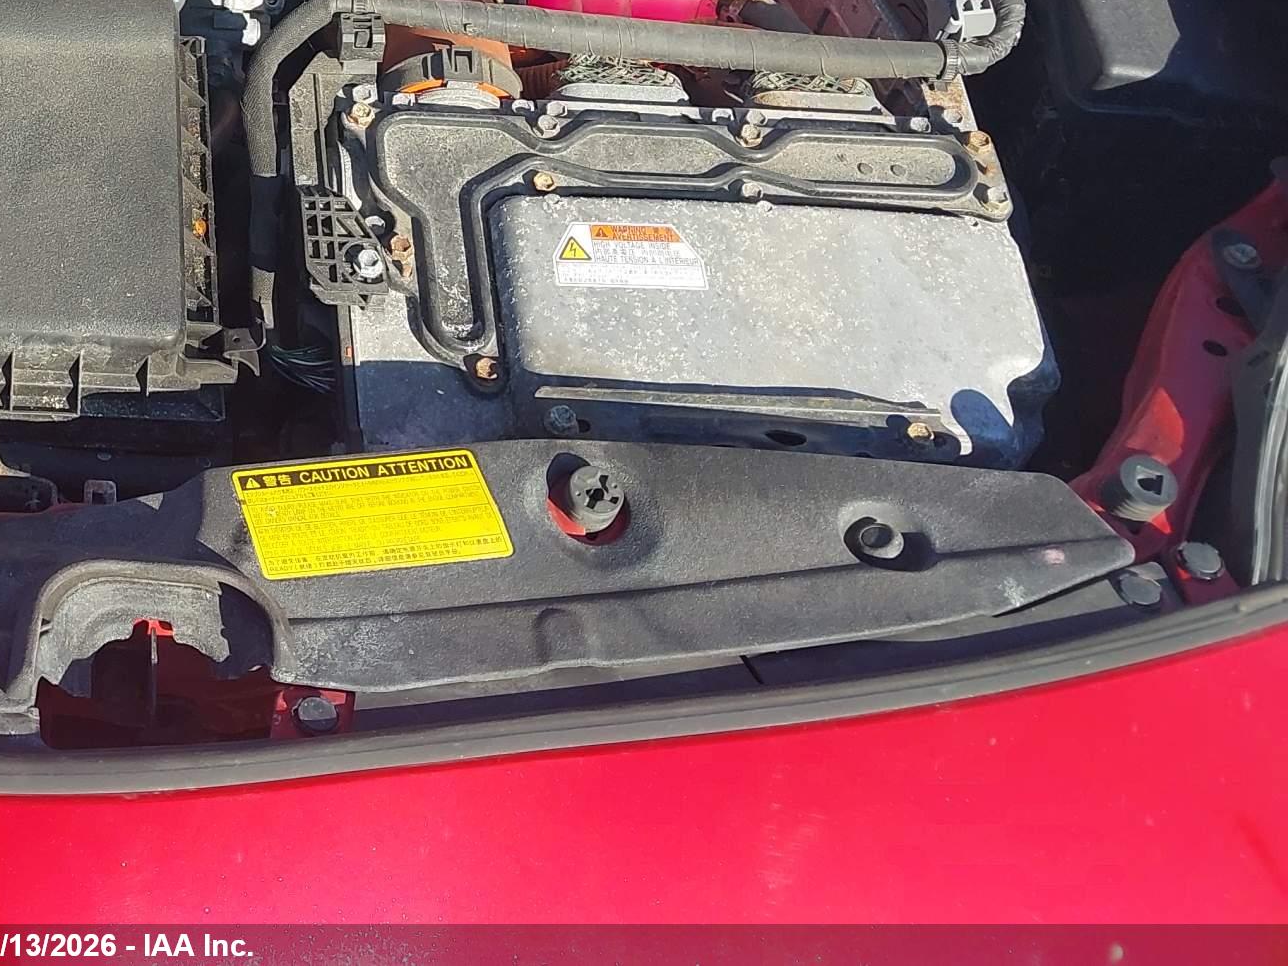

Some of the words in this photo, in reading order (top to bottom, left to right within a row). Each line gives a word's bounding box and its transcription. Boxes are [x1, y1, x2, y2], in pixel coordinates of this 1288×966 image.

[594, 241, 610, 249] HIGH
[262, 474, 292, 487] 警告
[299, 465, 370, 483] CAUTION
[377, 455, 469, 476] ATTENTION
